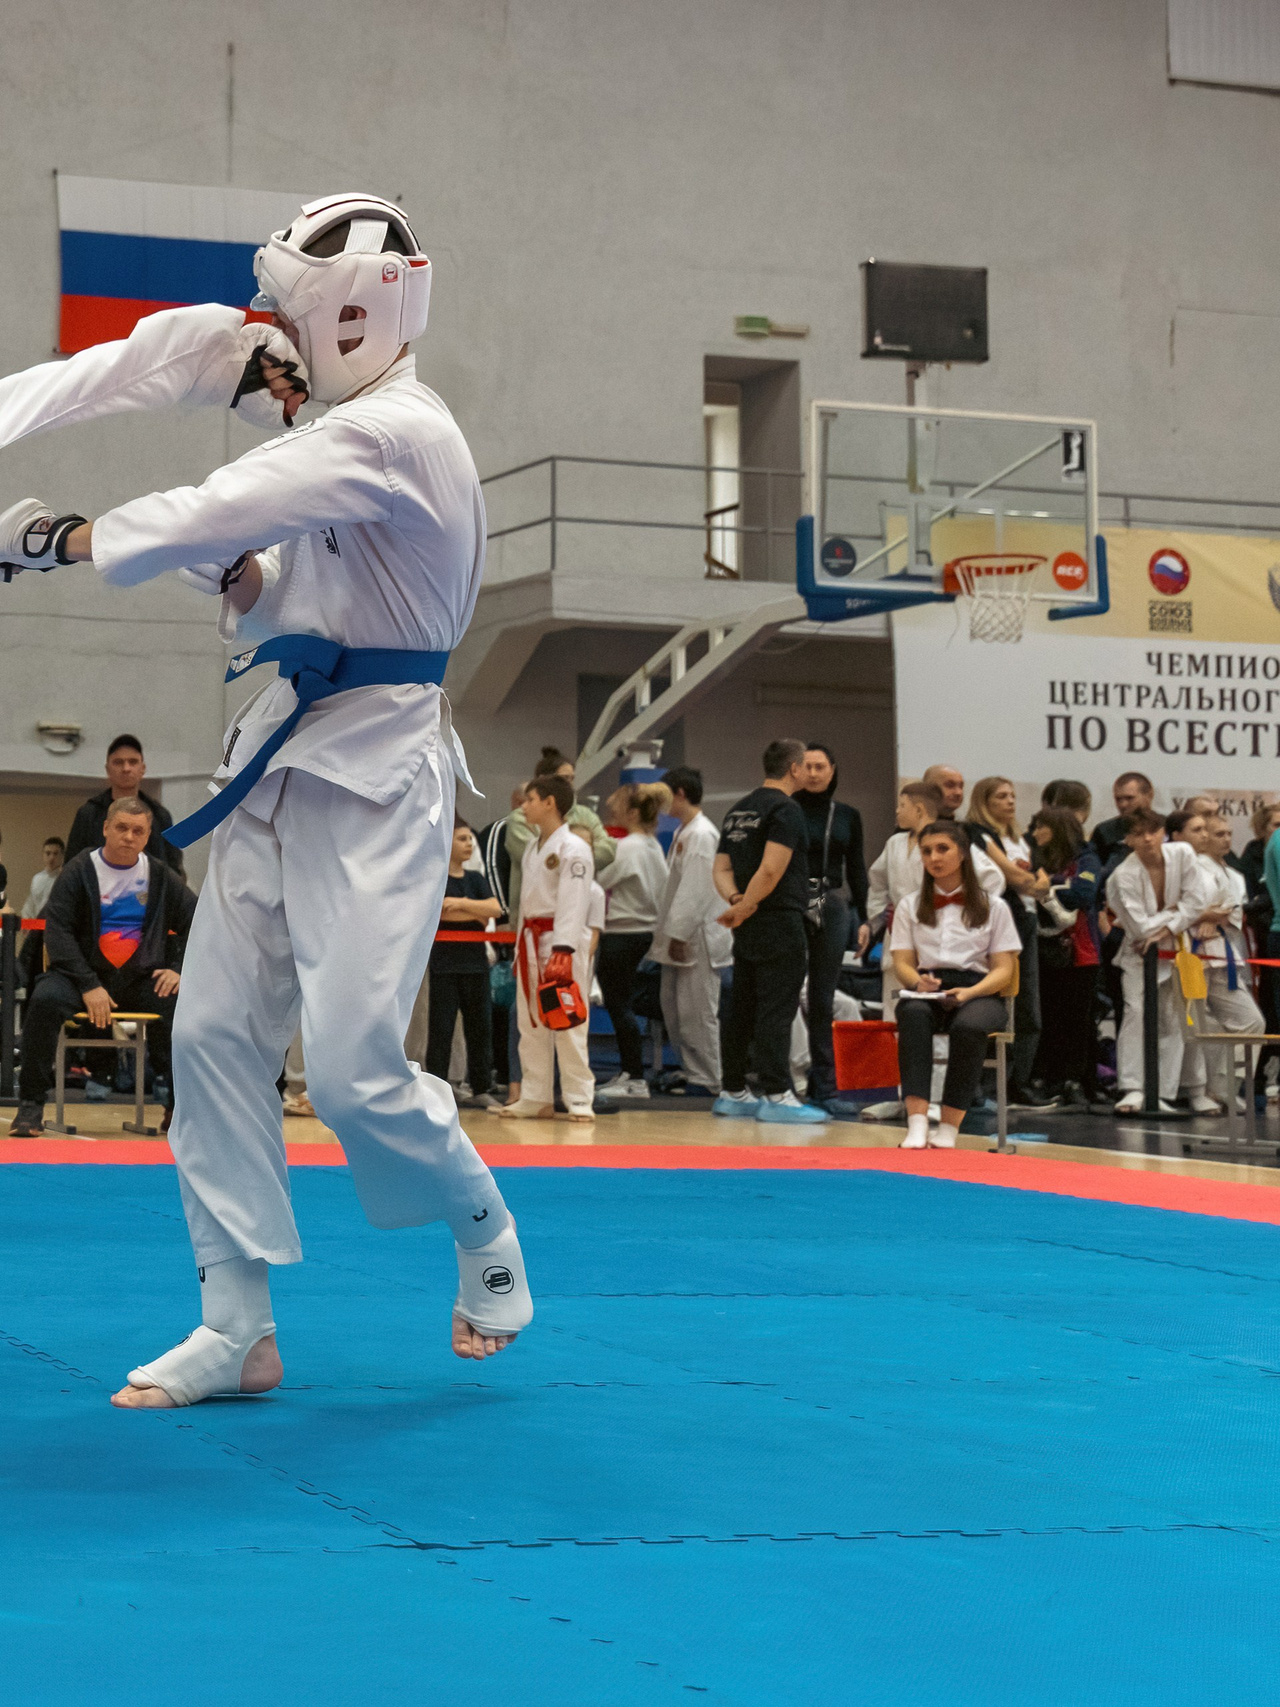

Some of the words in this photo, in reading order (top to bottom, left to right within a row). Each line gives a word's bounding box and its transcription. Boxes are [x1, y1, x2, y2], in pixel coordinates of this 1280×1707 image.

[1146, 651, 1280, 680] ЧЕМПИО
[1048, 680, 1280, 713] ЦЕНТРАЛЬНОГ
[1046, 714, 1107, 751] ПО
[1126, 717, 1280, 758] ВСЕСТ
[1172, 794, 1265, 816] УЖАЙ
